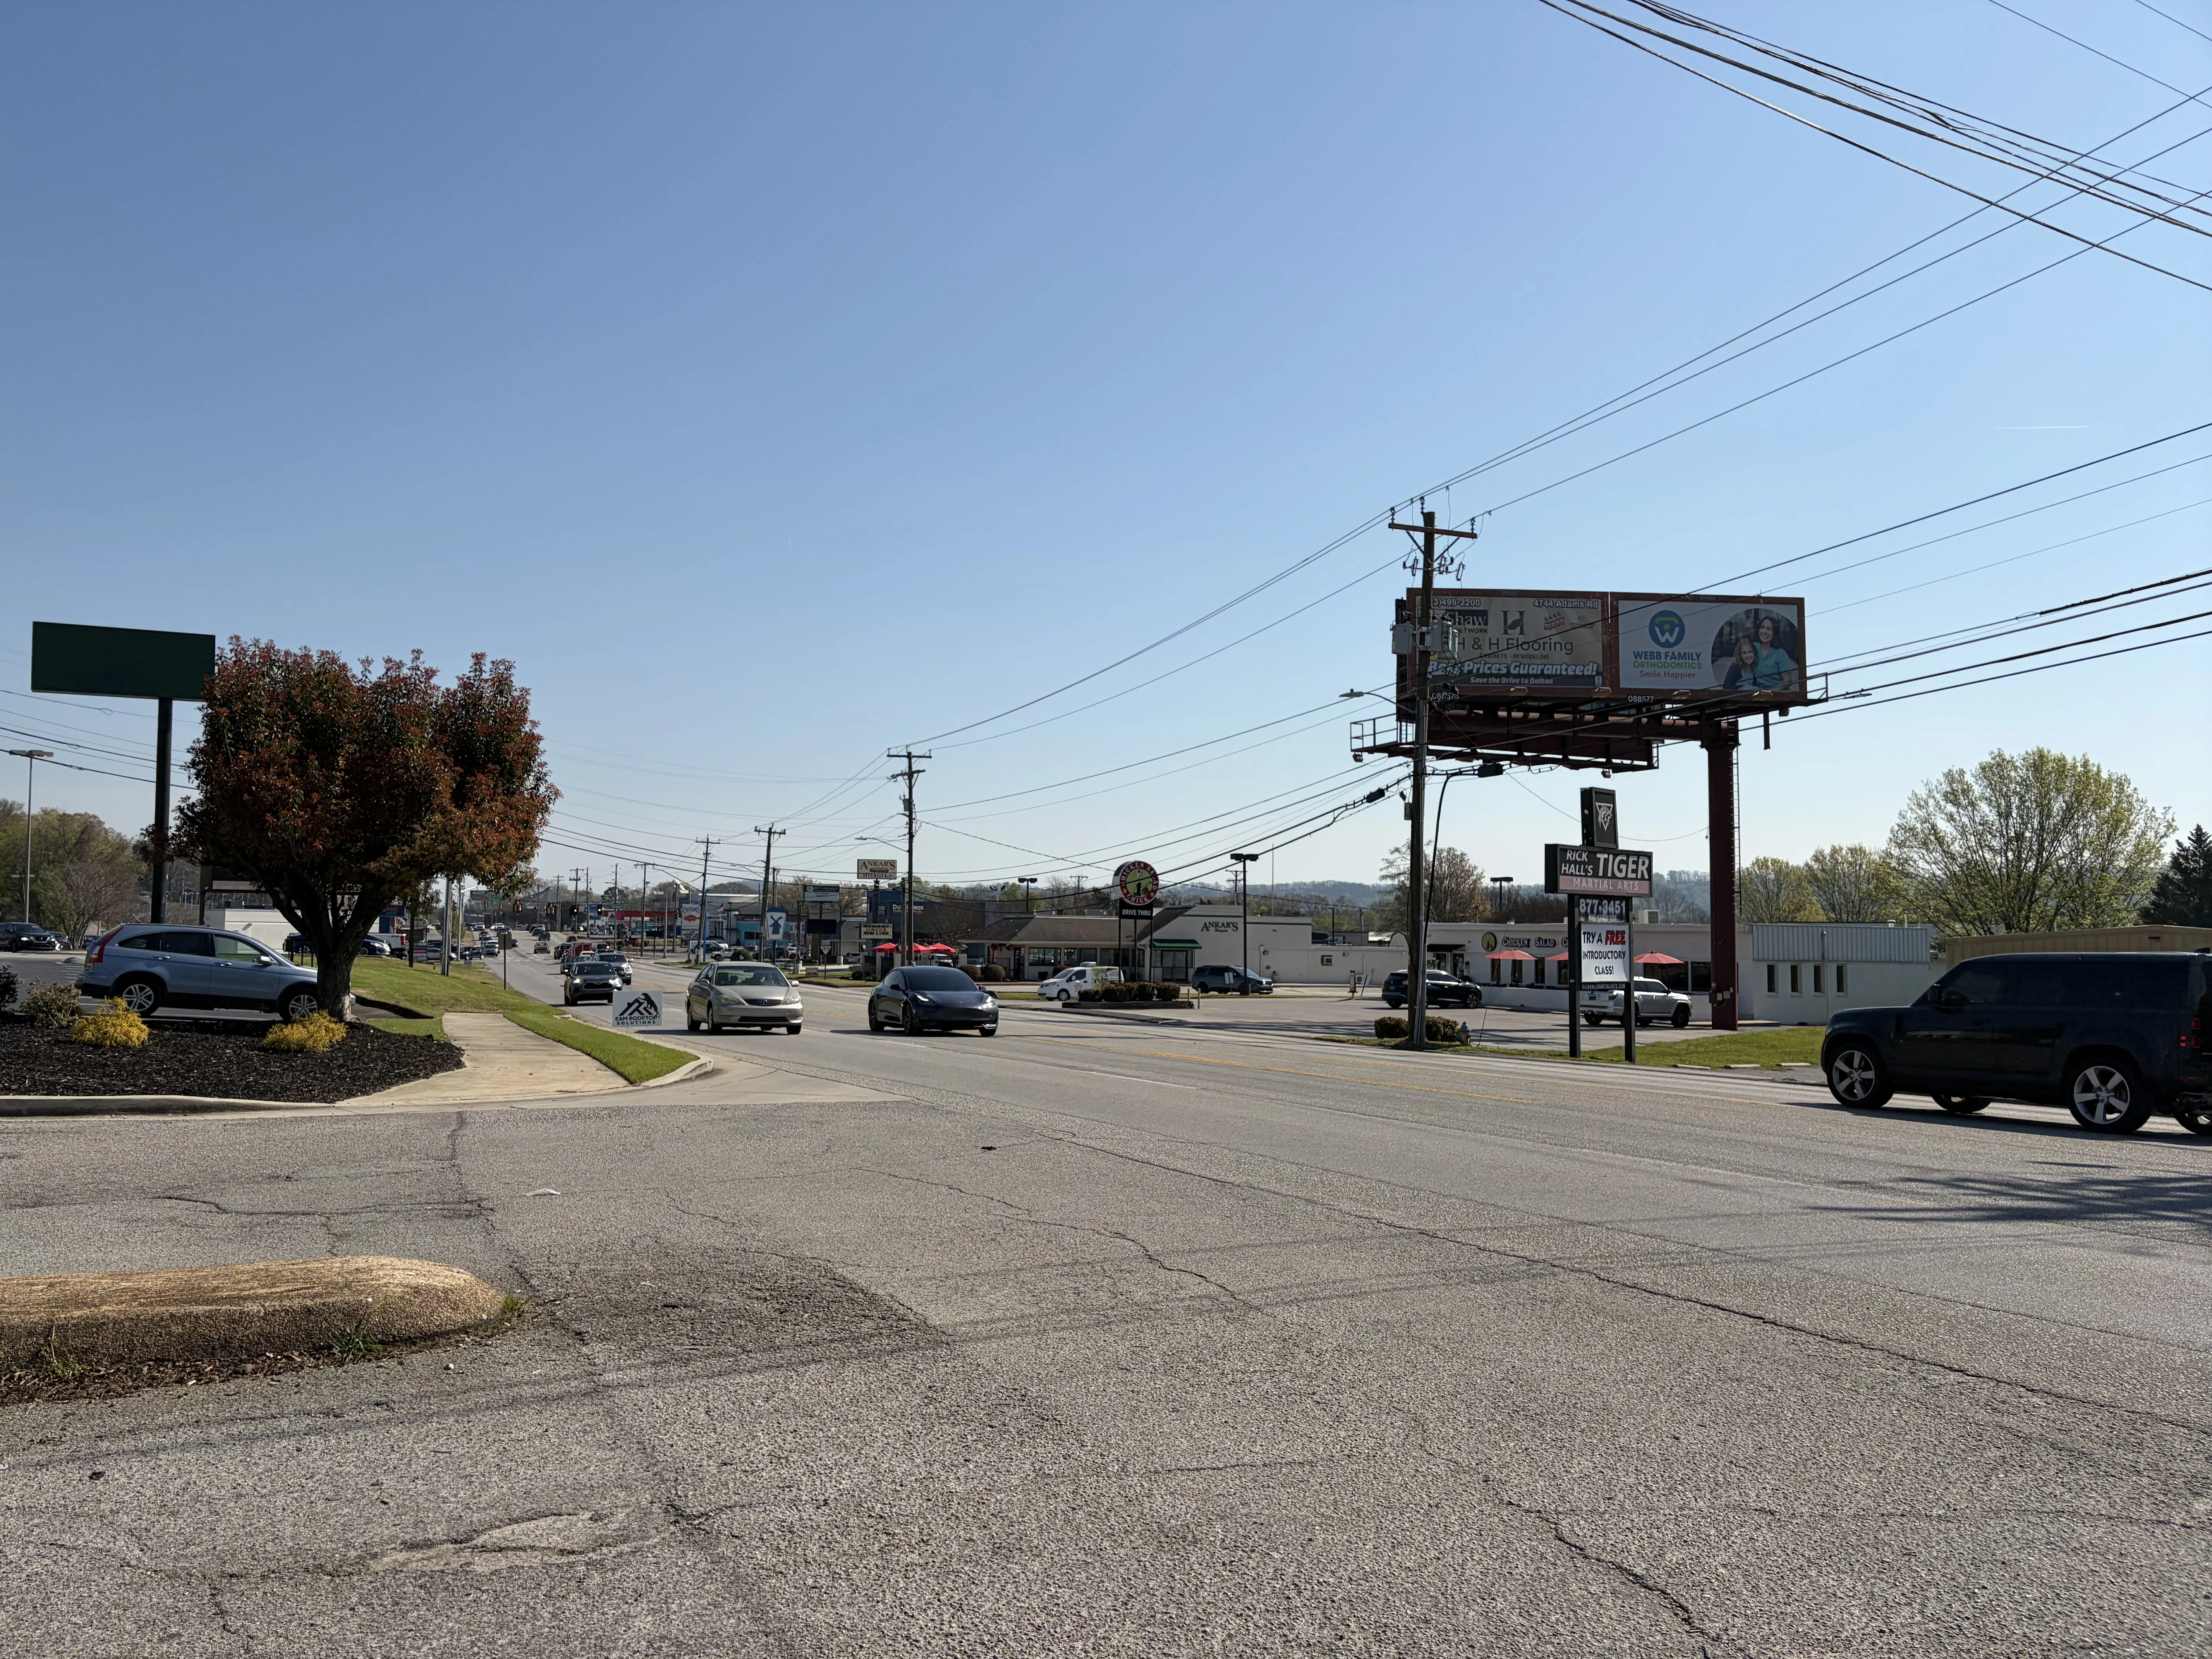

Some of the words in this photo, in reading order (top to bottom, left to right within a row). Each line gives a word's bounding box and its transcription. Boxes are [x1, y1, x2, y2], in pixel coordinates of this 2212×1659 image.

[1433, 598, 1480, 607] 3)498-2200
[1533, 599, 1553, 608] 4744
[1555, 600, 1585, 608] Adams
[1586, 601, 1599, 609] Rd
[1444, 611, 1486, 626] Shaw
[1472, 637, 1482, 650] &
[1489, 638, 1499, 650] H
[1507, 637, 1573, 655] Flooring
[1633, 651, 1662, 660] WEBB
[1665, 652, 1701, 661] FAMILY
[1464, 660, 1508, 674] Prices
[1510, 661, 1597, 675] Guaranteed!
[1633, 661, 1702, 669] ORTHODONTICS
[1664, 671, 1696, 679] Happier
[1566, 850, 1588, 862] RICK
[860, 861, 895, 870] ANKAR'S
[1561, 863, 1593, 876] HALL'S
[1596, 853, 1649, 879] TIGER
[1146, 866, 1158, 890] SAAD
[1573, 878, 1613, 890] MARTIAL
[1617, 881, 1638, 891] ARTS
[1127, 894, 1150, 903] CHICK
[1201, 921, 1238, 932] ANKAR'S
[1503, 937, 1528, 946] CHICKEN
[1535, 937, 1554, 946] SALAD
[1583, 932, 1596, 944] TRY
[1596, 933, 1602, 943] A
[1605, 930, 1626, 945] FREE
[1583, 951, 1626, 960] INTRODUCTORY
[1595, 965, 1614, 975] CLASS!
